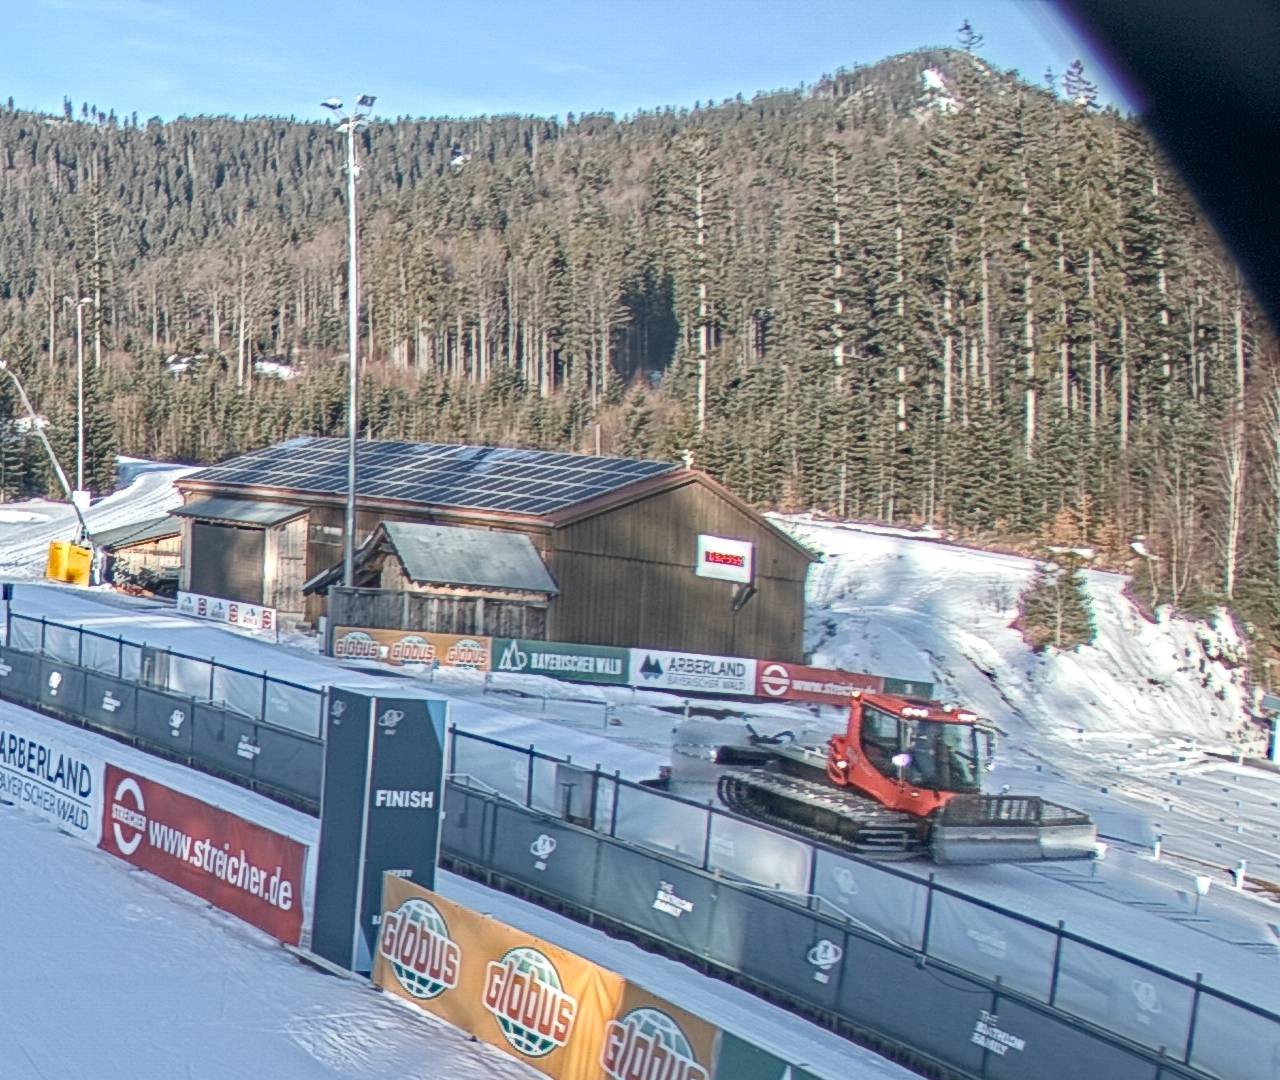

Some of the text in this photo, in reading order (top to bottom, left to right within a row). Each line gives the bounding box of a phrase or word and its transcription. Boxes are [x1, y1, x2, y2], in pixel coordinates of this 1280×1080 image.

[668, 657, 746, 677] ARBERLAND
[375, 789, 434, 809] FINISH
[56, 802, 89, 831] WALD
[149, 820, 293, 910] www.streicher.de
